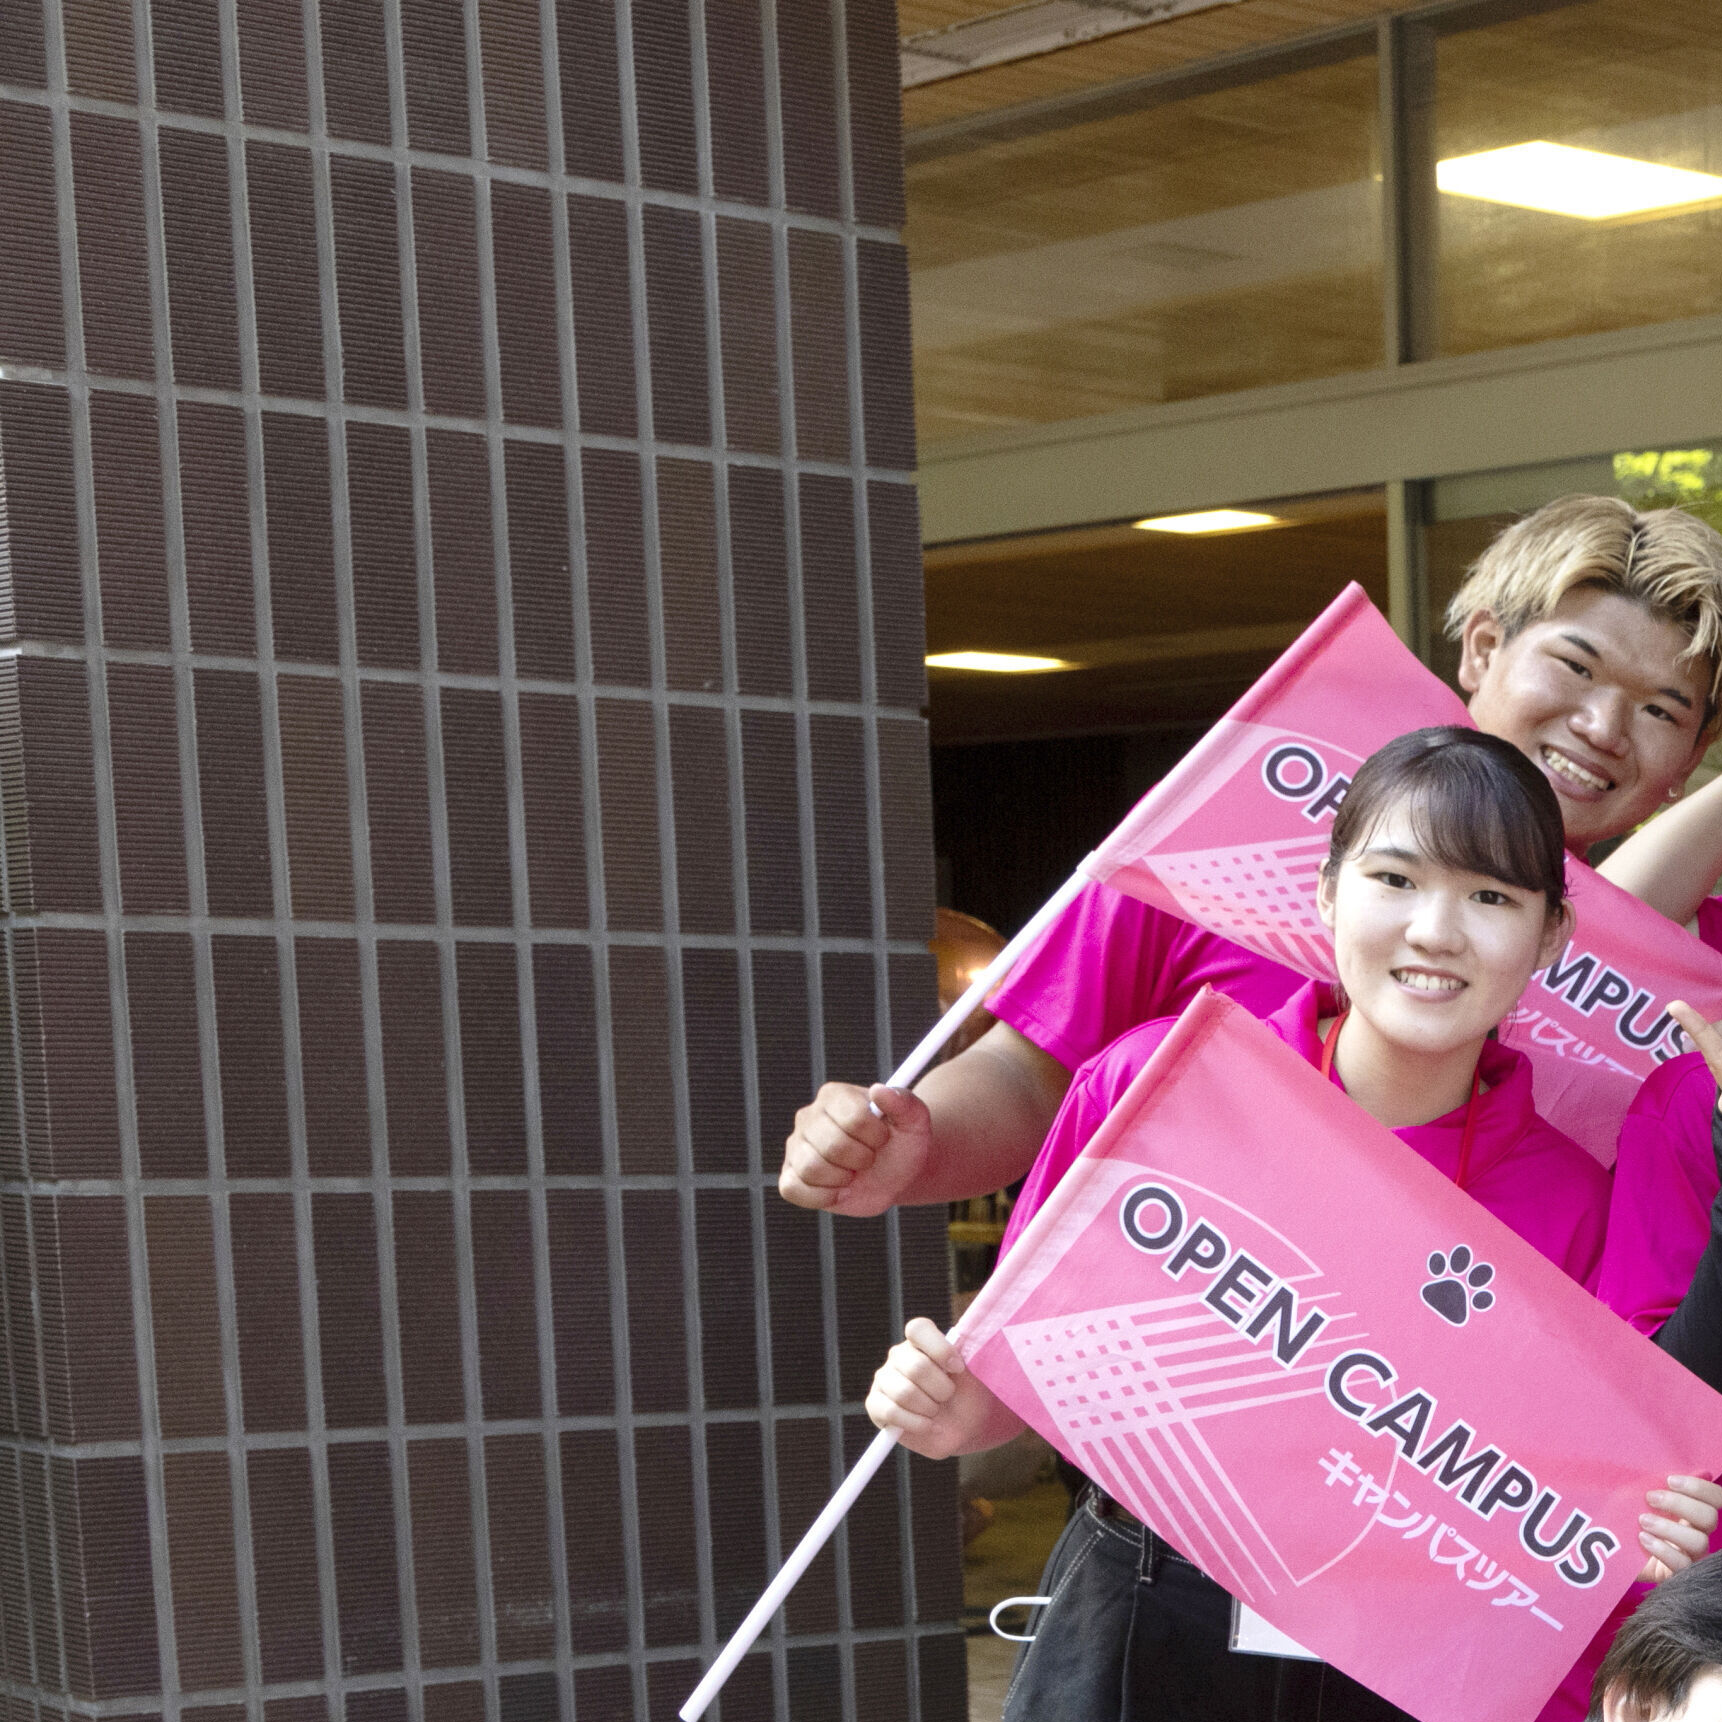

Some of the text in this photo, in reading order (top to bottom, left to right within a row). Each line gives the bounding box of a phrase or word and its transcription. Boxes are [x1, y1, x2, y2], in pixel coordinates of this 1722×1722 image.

[1118, 1182, 1623, 1590] OPEN CAMPUS
[1317, 1446, 1564, 1633] キャンパスツアー
